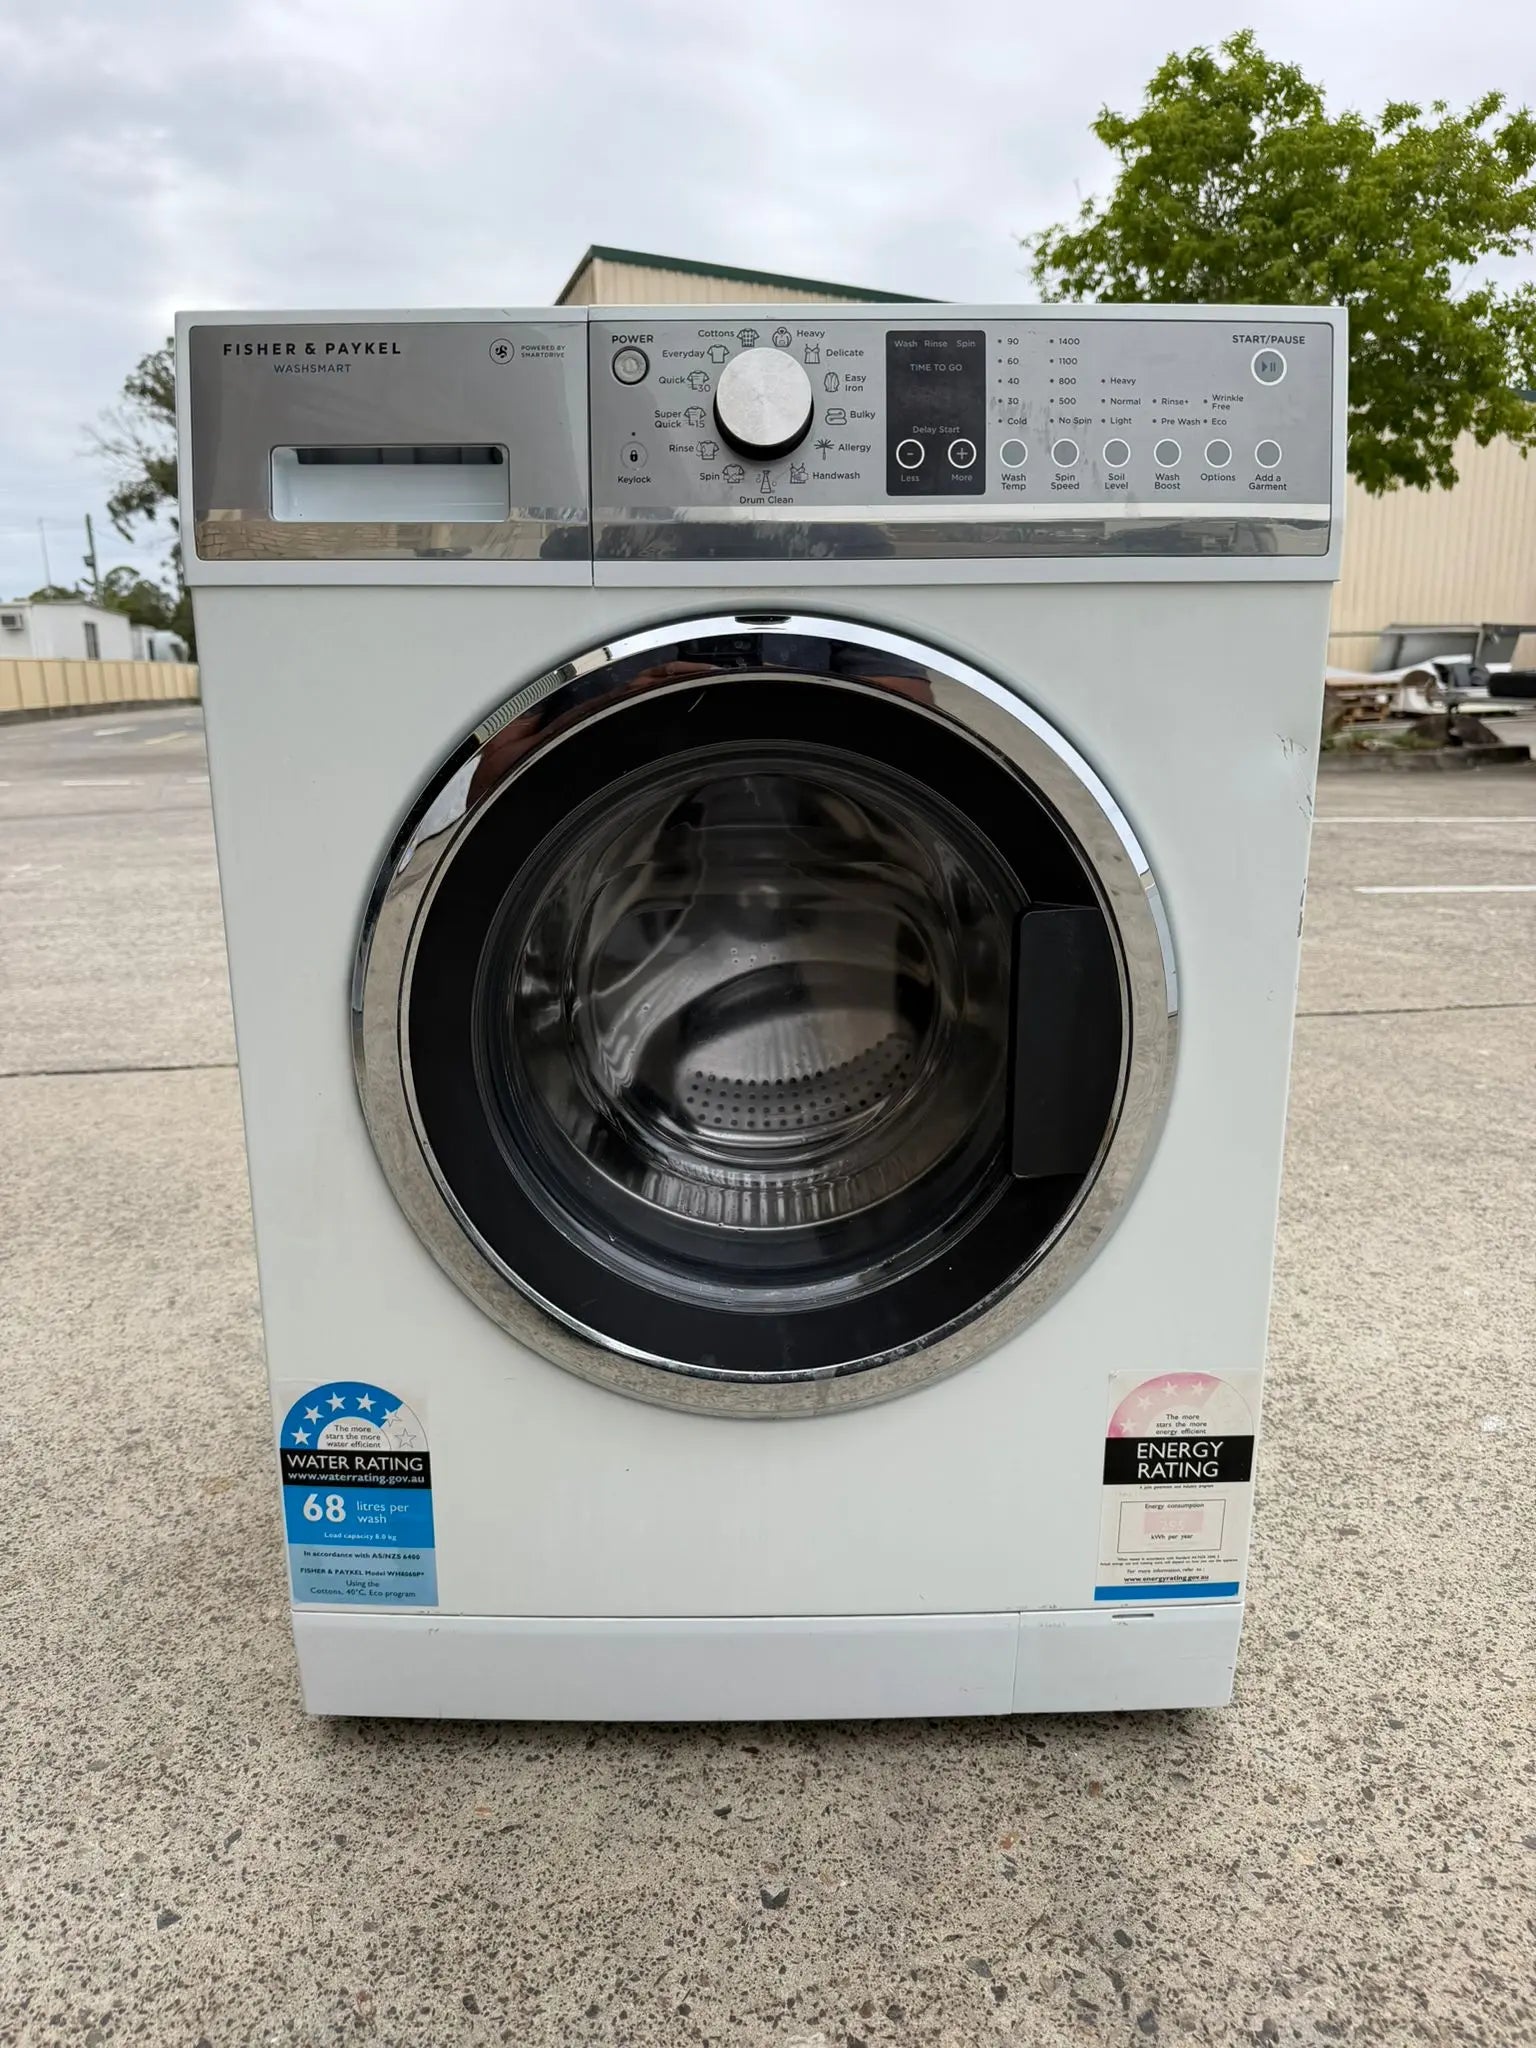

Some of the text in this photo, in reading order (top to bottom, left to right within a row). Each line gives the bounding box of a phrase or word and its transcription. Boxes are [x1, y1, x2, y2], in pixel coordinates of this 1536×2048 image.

[698, 329, 735, 338] Cottons
[797, 329, 825, 338] Heavy
[612, 335, 653, 343] POWER
[1232, 335, 1305, 344] START/PAUSE
[895, 340, 976, 348] Wash Rinse Spin
[224, 342, 402, 356] FISHER & PAYKEL
[826, 349, 864, 357] Delicate
[662, 349, 705, 359] Everyday
[273, 364, 352, 373] WASHSMART
[659, 376, 685, 385] Quick
[845, 374, 866, 383] Easy
[1110, 377, 1136, 385] Heavy
[697, 383, 711, 393] 30
[845, 384, 864, 392] Iron
[654, 410, 682, 420] Super
[850, 411, 875, 420] Bulky
[654, 420, 682, 429] Quick
[1110, 417, 1132, 425] Light
[913, 426, 937, 434] Delay
[669, 444, 694, 452] Rinse
[838, 443, 871, 452] Allergy
[617, 475, 651, 484] Keylock
[700, 472, 720, 482] Spin
[812, 472, 860, 480] Handwash
[901, 474, 920, 482] Less
[1055, 474, 1075, 482] Spin
[1200, 474, 1236, 482] Options
[1255, 474, 1273, 482] Add
[1001, 483, 1026, 491] Temp
[1051, 482, 1079, 491] Speed
[1105, 482, 1129, 490] Level
[1155, 482, 1181, 490] Boost
[1249, 483, 1287, 491] Garment
[739, 495, 793, 504] Drum Clean
[1137, 1441, 1224, 1460] ENERGY
[287, 1454, 423, 1472] WATER RATING
[1137, 1462, 1219, 1479] RATING
[288, 1472, 425, 1485] www.waterrating.gov.au
[303, 1493, 346, 1523] 68
[357, 1501, 409, 1515] litres per
[358, 1514, 387, 1524] wash
[346, 1580, 366, 1588] Using
